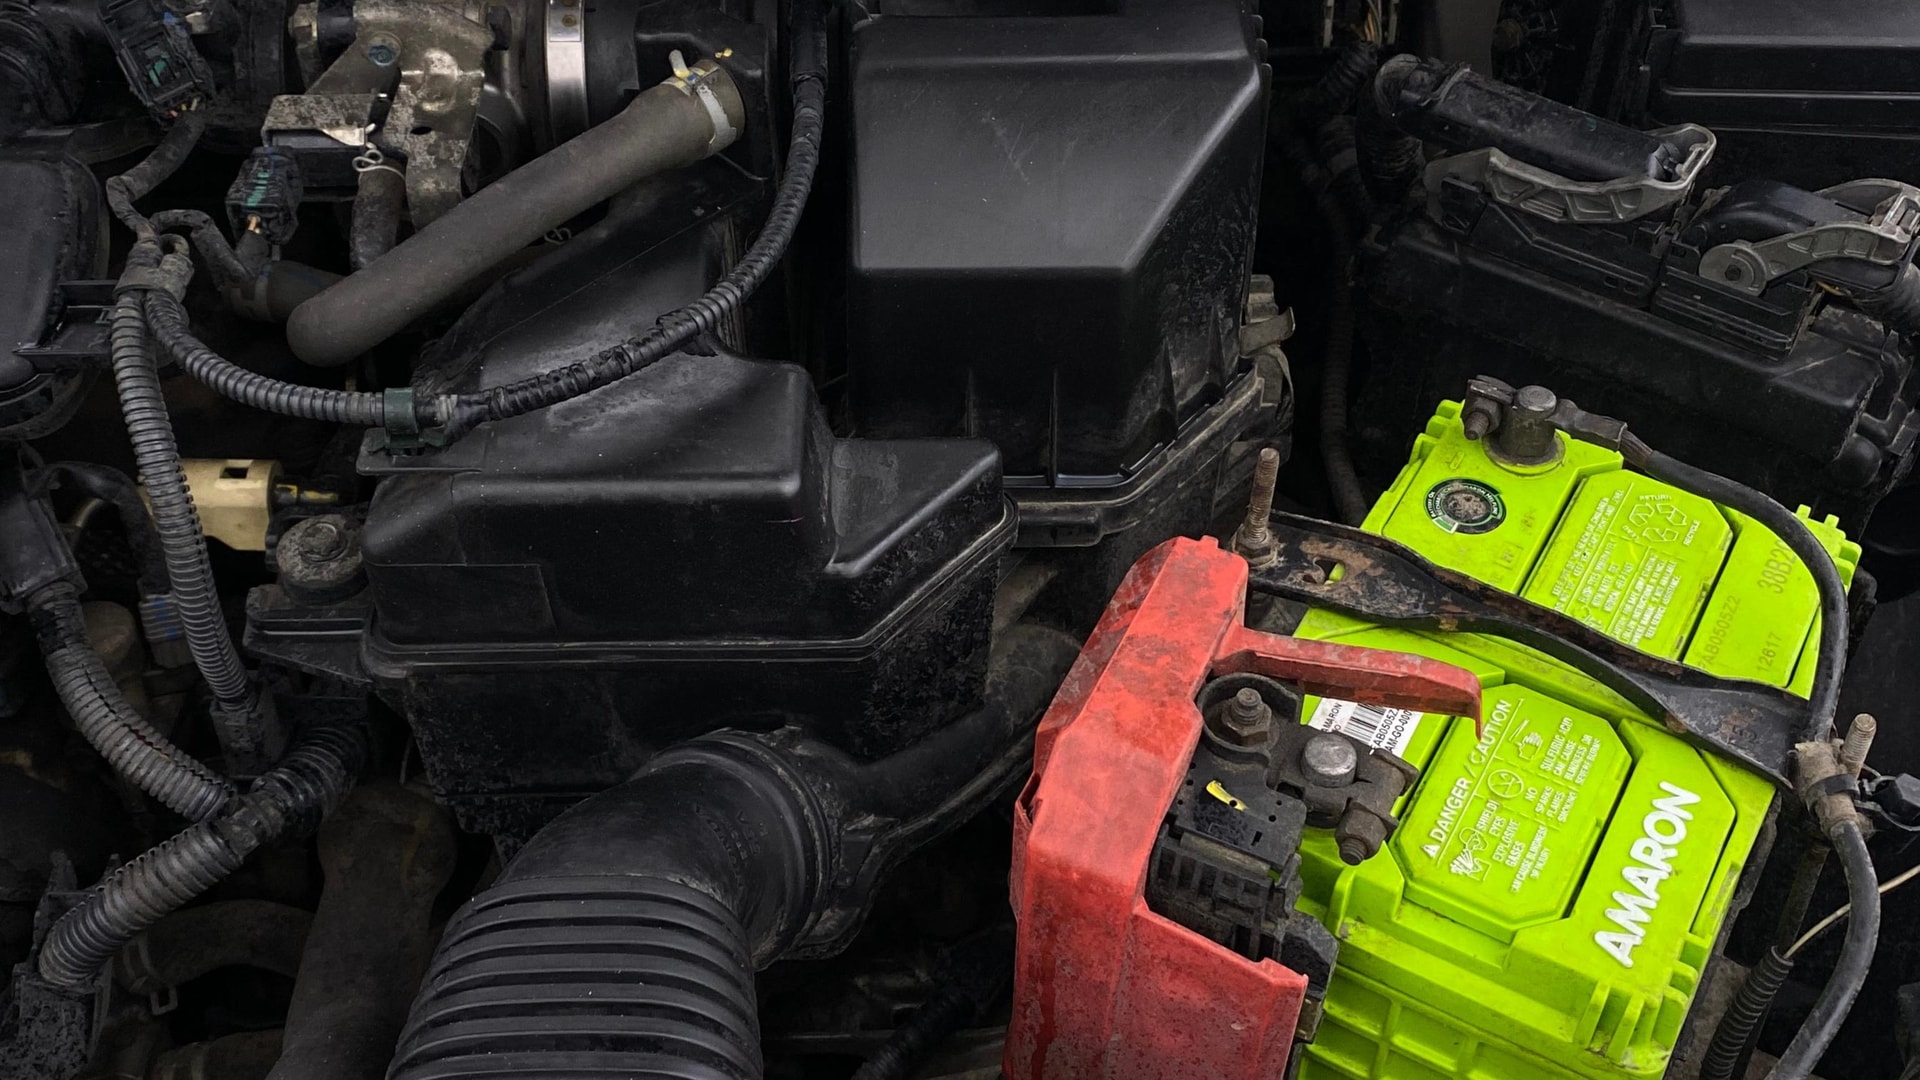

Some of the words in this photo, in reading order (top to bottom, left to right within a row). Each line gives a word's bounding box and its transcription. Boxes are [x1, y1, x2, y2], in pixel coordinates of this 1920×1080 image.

[1757, 631, 1782, 673] 12617
[1540, 735, 1565, 771] SULFURIC
[1430, 777, 1471, 842] DANGER
[1471, 700, 1511, 763] CAUTION
[1525, 787, 1538, 801] NO
[1535, 786, 1554, 813] SPARKS
[1546, 791, 1566, 817] FLAMES
[1557, 791, 1577, 822] SMOKING
[1488, 815, 1506, 837] EYES
[1492, 819, 1519, 862] EXPLOSIVE
[1505, 840, 1526, 867] GASES
[1594, 781, 1701, 968] AMARON
